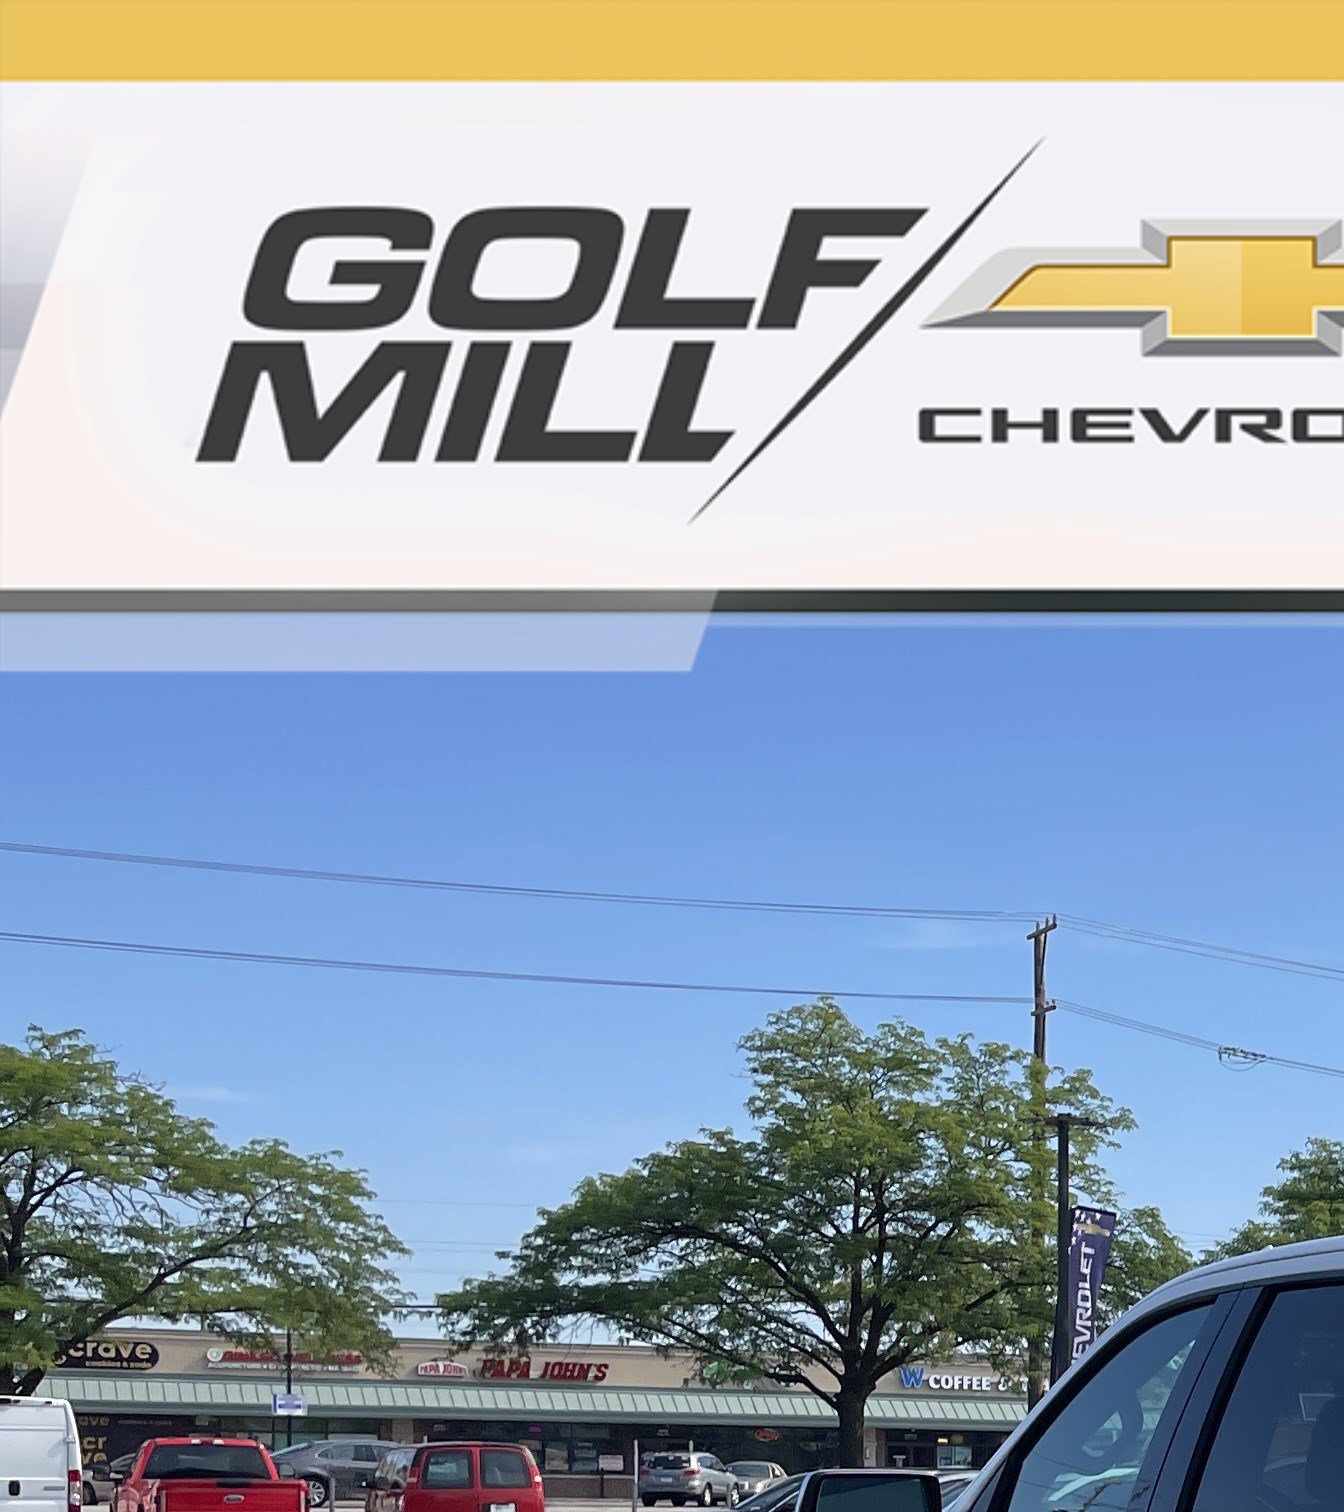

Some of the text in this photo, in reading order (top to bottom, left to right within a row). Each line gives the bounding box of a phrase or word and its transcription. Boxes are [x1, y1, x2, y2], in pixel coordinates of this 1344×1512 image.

[481, 1358, 610, 1382] PAPA JOHN'S
[900, 1365, 925, 1389] W
[928, 1374, 992, 1391] COFFEE
